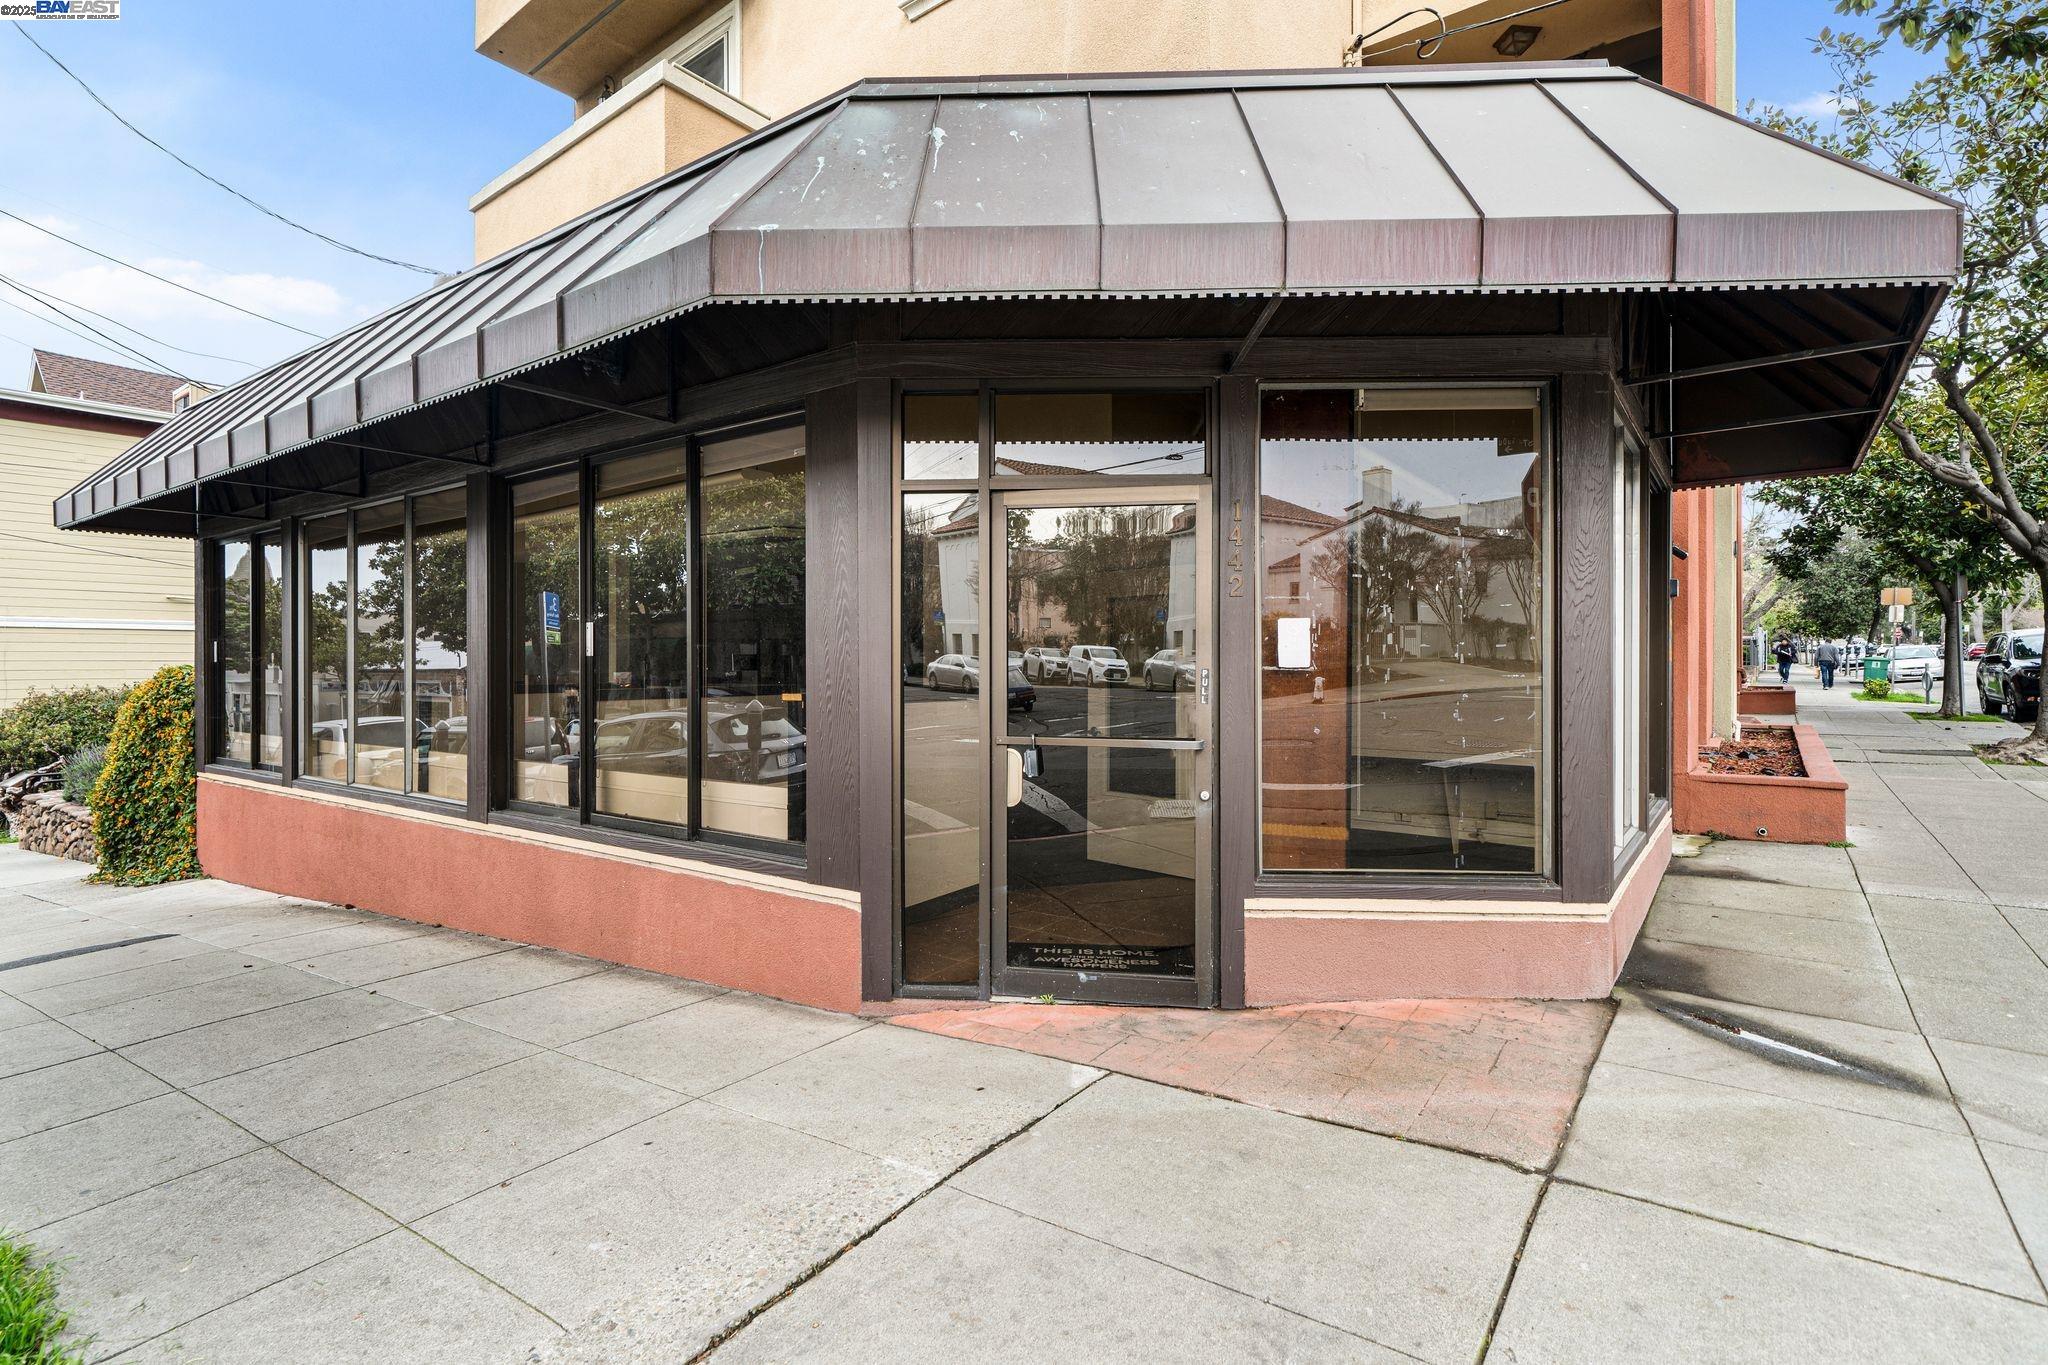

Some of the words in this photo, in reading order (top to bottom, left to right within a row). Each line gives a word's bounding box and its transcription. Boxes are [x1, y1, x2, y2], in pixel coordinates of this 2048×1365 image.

[1227, 501, 1244, 597] 1442
[1201, 669, 1209, 704] PULL
[1034, 956, 1160, 966] AWESOMENESS
